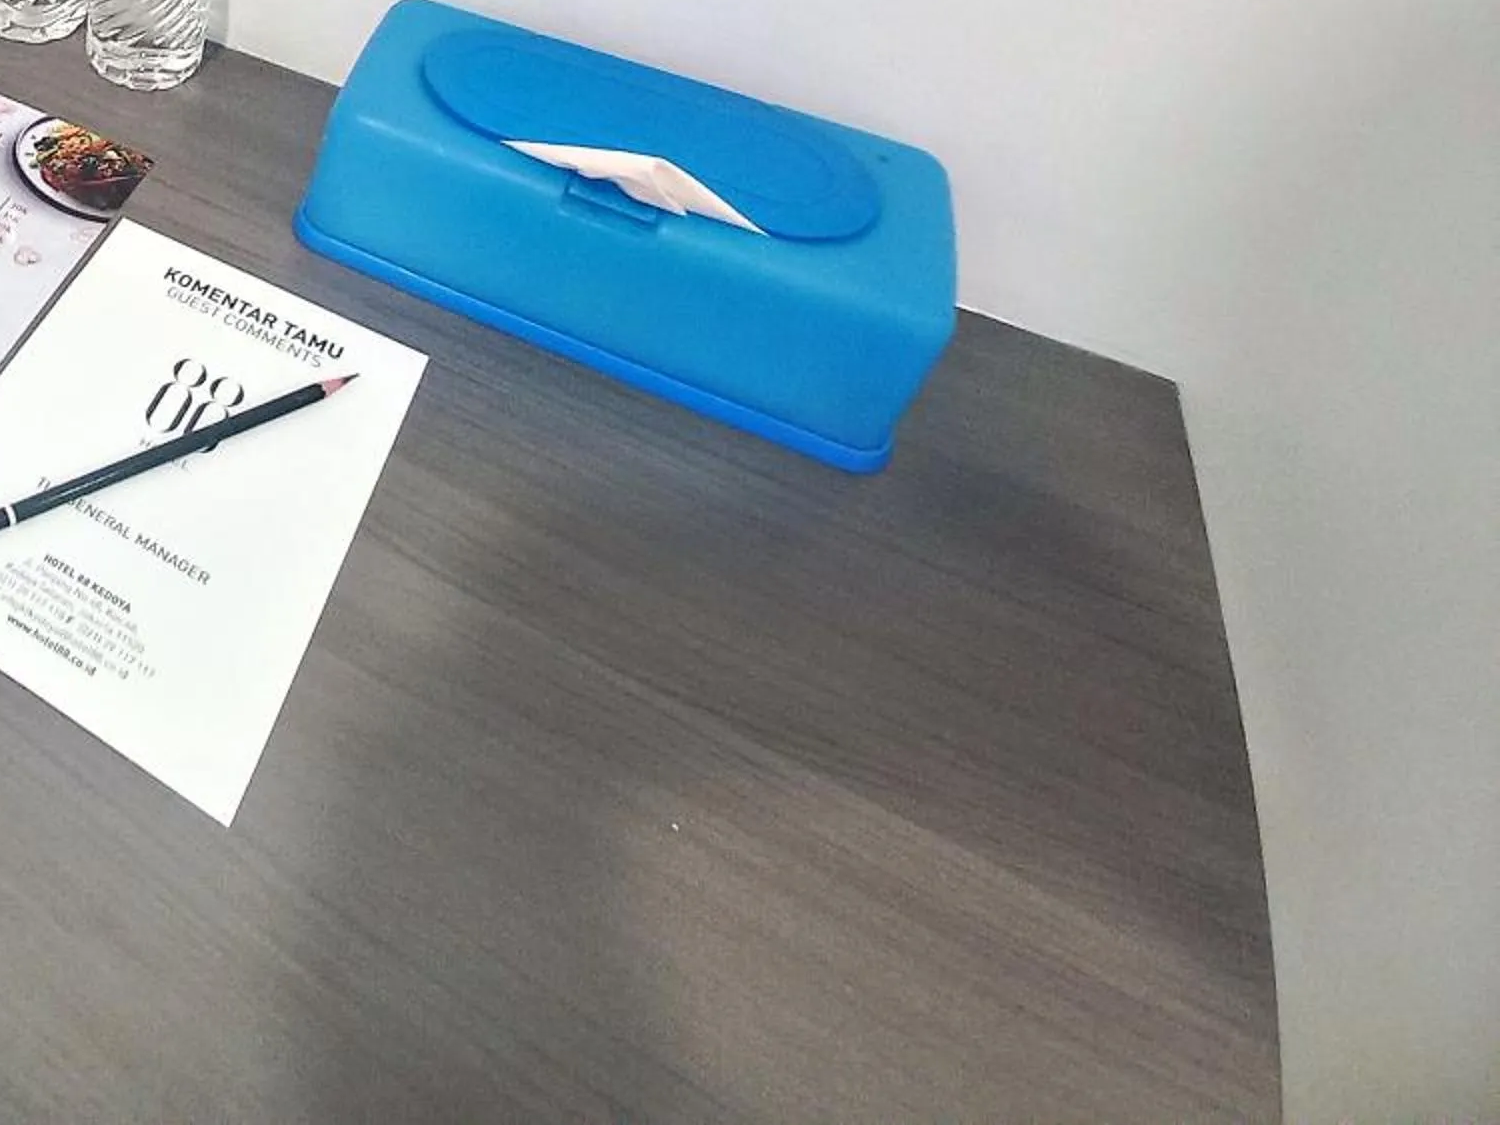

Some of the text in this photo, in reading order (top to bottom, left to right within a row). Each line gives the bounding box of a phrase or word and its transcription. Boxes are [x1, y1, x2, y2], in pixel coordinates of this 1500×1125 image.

[163, 267, 344, 360] KOMENTAR TAMU
[167, 286, 321, 368] GUEST COMMENTS
[145, 358, 245, 454] 88
[43, 554, 75, 579] HOTEL
[90, 582, 131, 614] KEDOYA
[134, 534, 211, 586] MANAGER
[7, 614, 97, 677] www.hotel88.co.id
